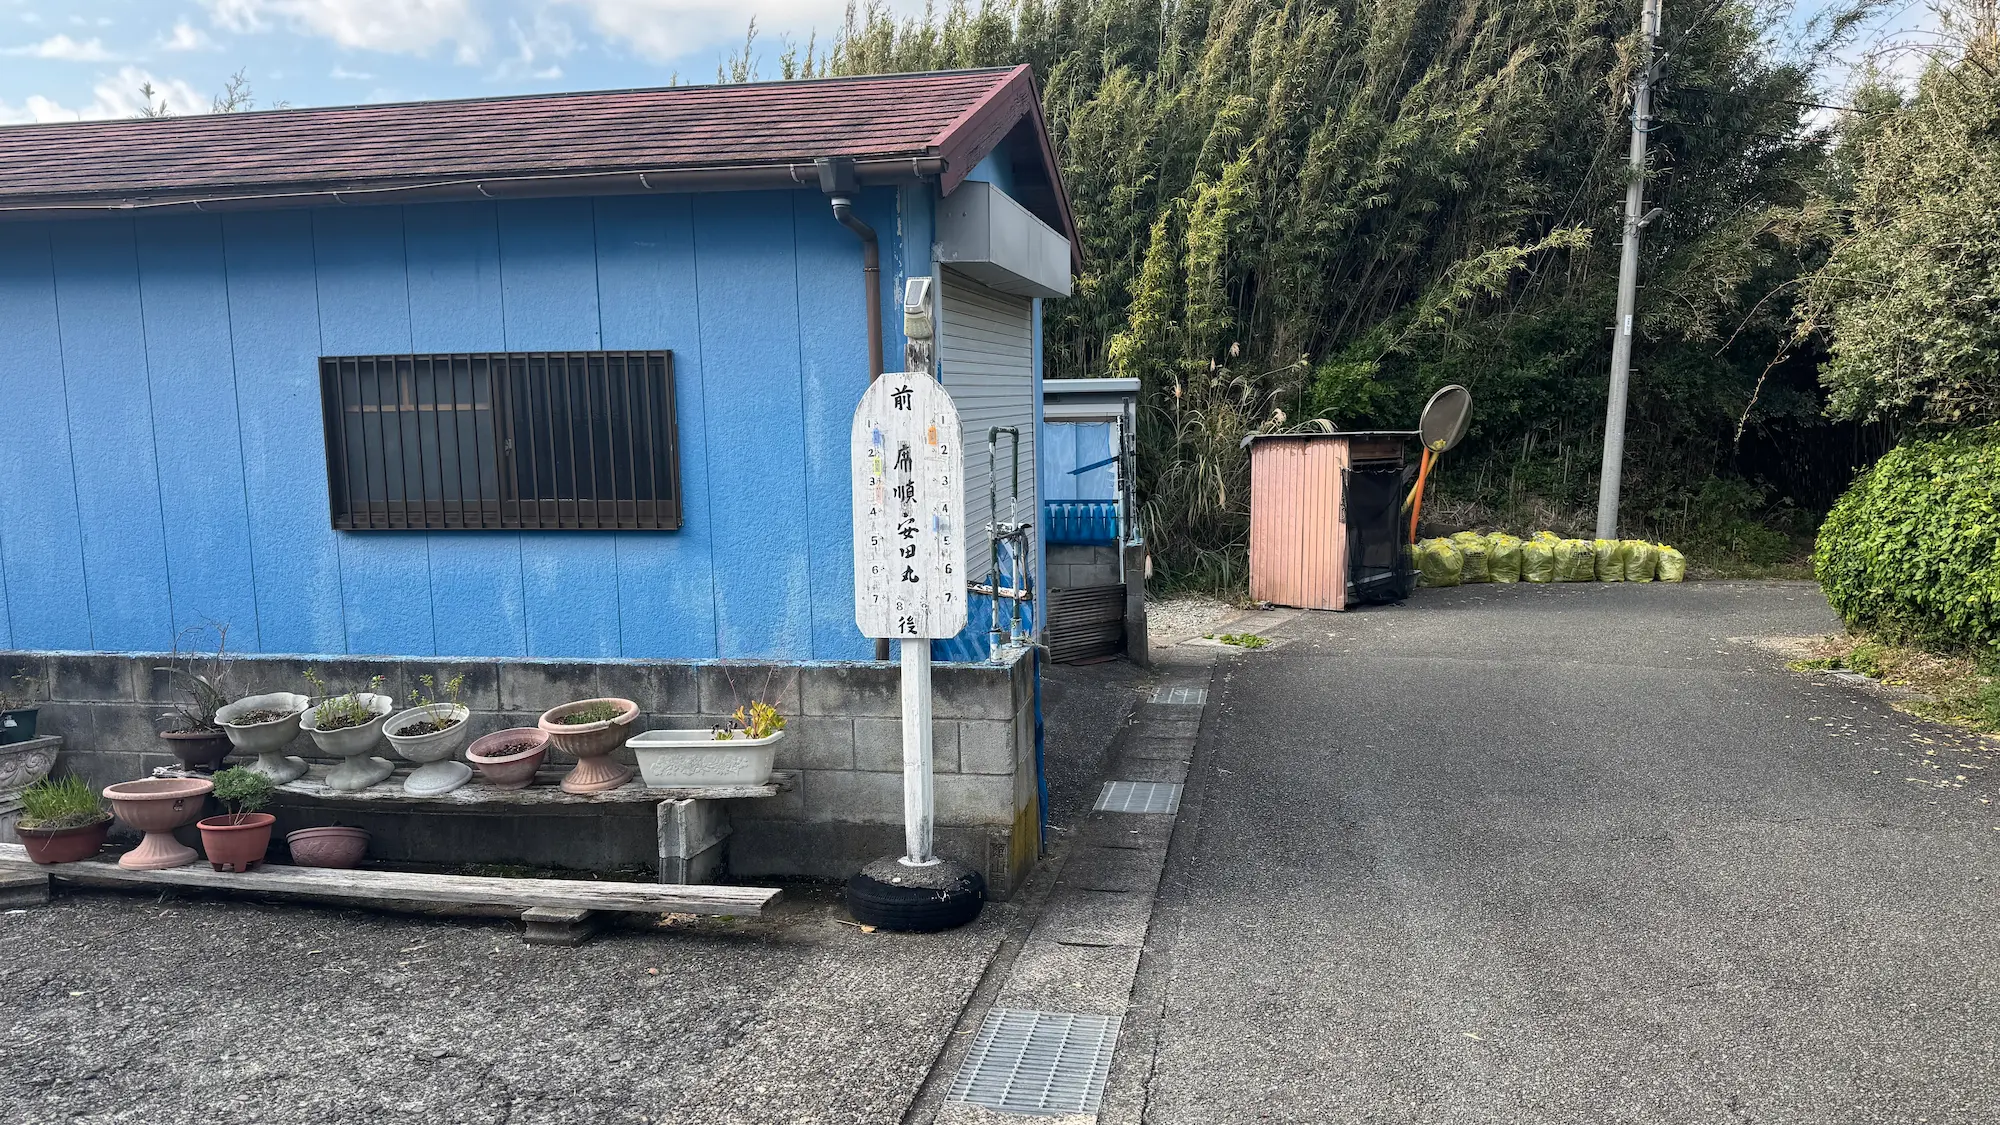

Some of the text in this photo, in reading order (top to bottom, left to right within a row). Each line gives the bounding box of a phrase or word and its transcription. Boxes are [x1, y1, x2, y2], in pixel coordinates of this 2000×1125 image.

[891, 384, 914, 411] 前
[868, 448, 875, 457] 2
[941, 444, 948, 455] 2
[869, 477, 876, 486] 3
[941, 475, 949, 486] 3
[870, 507, 877, 517] 4
[942, 503, 949, 513] 4
[871, 535, 878, 546] 5
[871, 565, 879, 575] 6
[945, 563, 953, 575] 6
[872, 594, 879, 604] 7
[944, 592, 952, 603] 7
[896, 601, 904, 611] 8
[898, 615, 918, 635] 後
